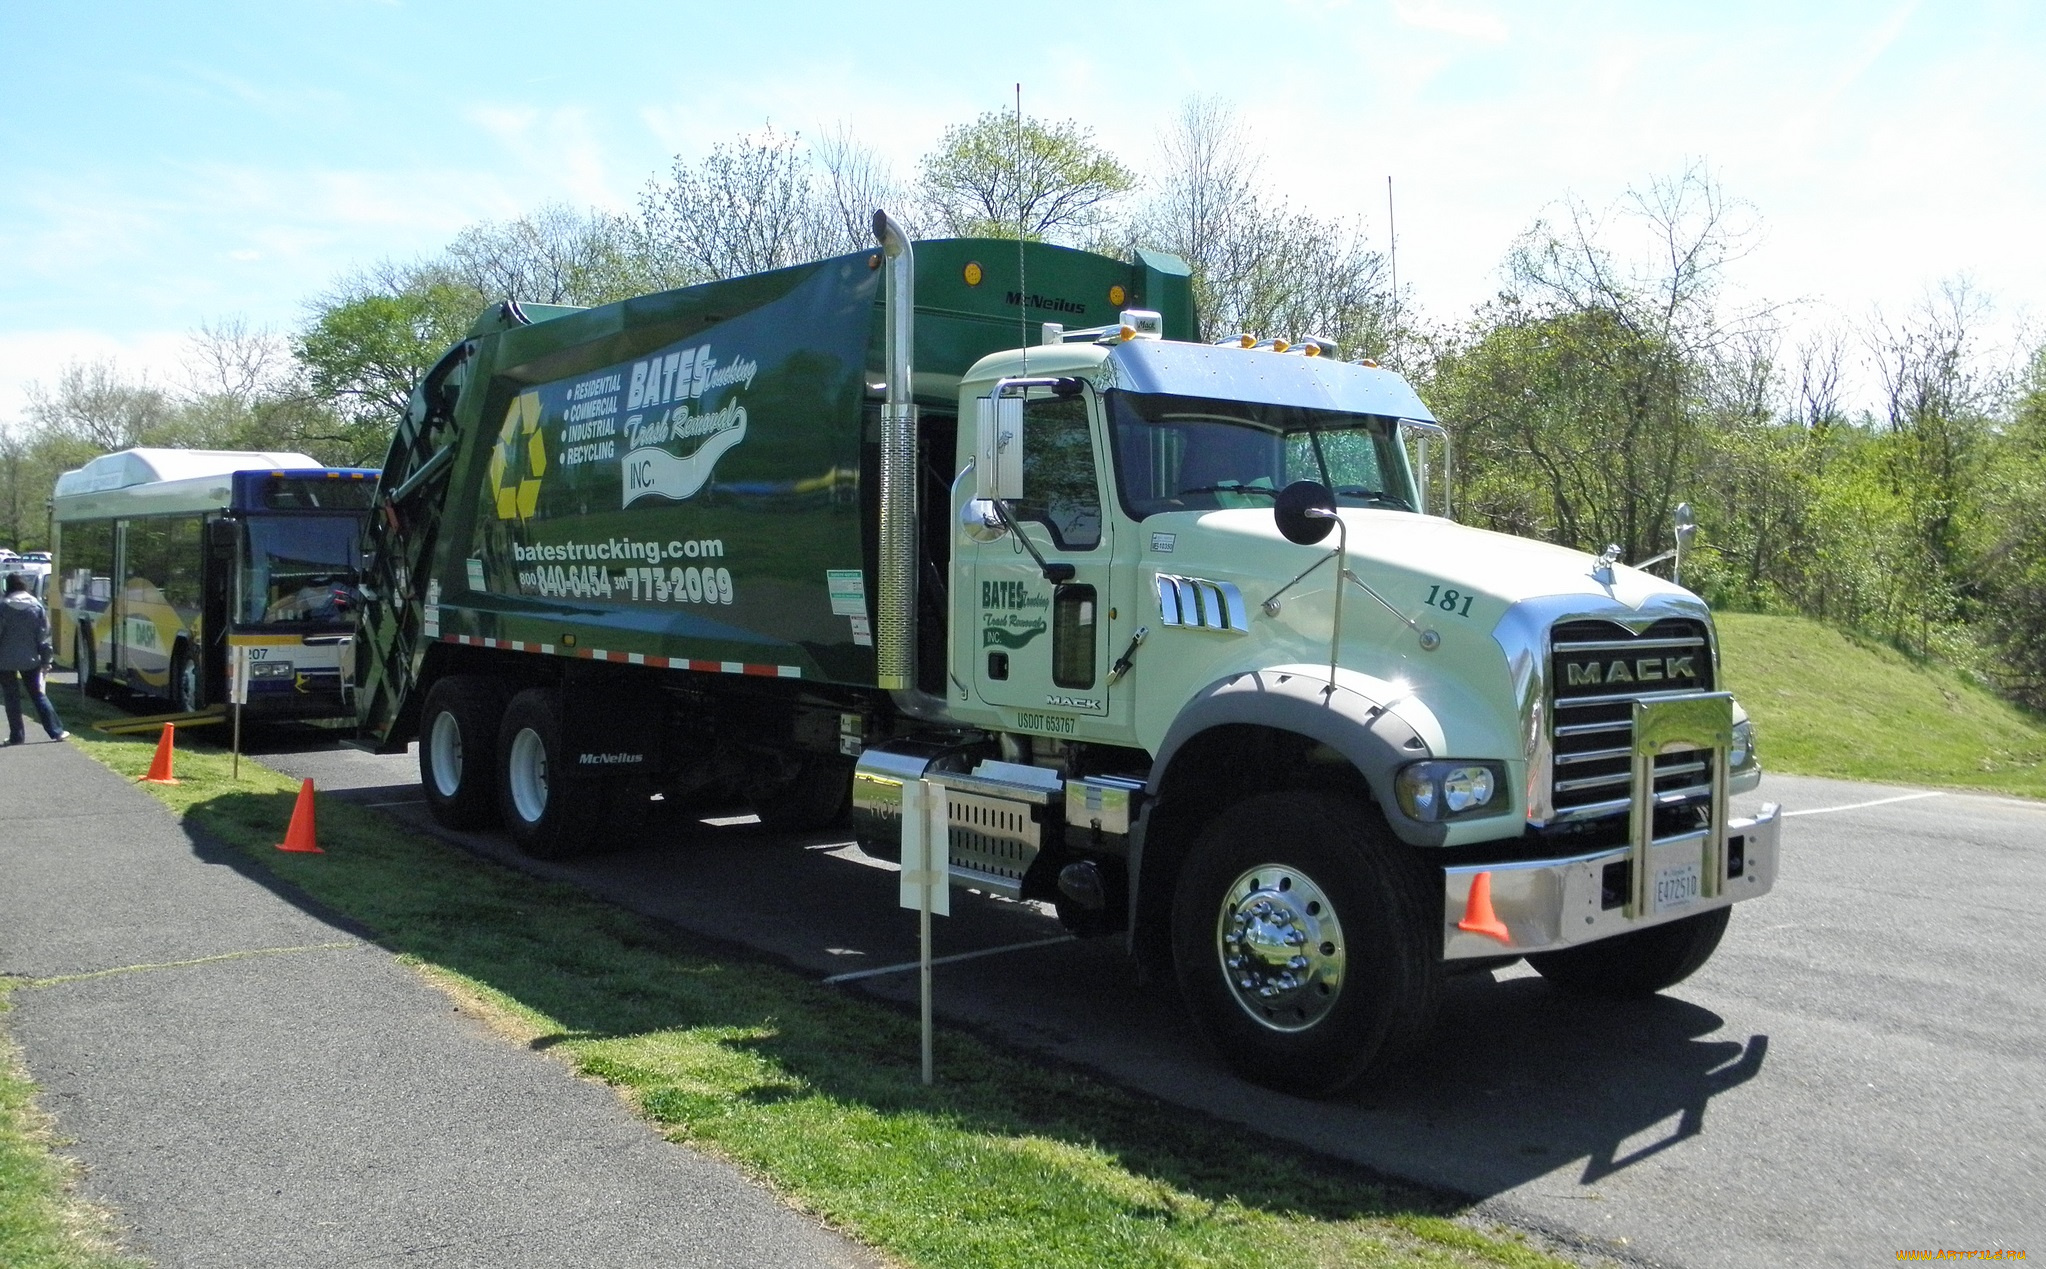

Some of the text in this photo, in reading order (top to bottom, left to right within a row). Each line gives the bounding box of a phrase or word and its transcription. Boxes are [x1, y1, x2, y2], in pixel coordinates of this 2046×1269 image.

[1006, 291, 1086, 314] McNeilus
[573, 373, 621, 401] RESIDENTIAL
[627, 343, 757, 411] BATES Trucking
[570, 395, 618, 423] COMMERCIAL
[568, 417, 616, 443] INDUSTRIAL
[624, 396, 738, 450] Trash Removal
[567, 440, 615, 465] RECYCLING
[630, 460, 655, 490] INC.
[513, 538, 724, 564] batestrucking.com
[519, 565, 733, 605] 800 840-6454 301 773-2069
[982, 581, 1024, 611] BATES
[1424, 585, 1474, 618] 181
[136, 623, 156, 649] DASH
[987, 631, 1002, 643] INC.
[1567, 656, 1697, 686] MACK
[1046, 694, 1101, 711] MACK
[1017, 712, 1075, 733] USDOT 653767
[579, 752, 643, 764] McNeilus
